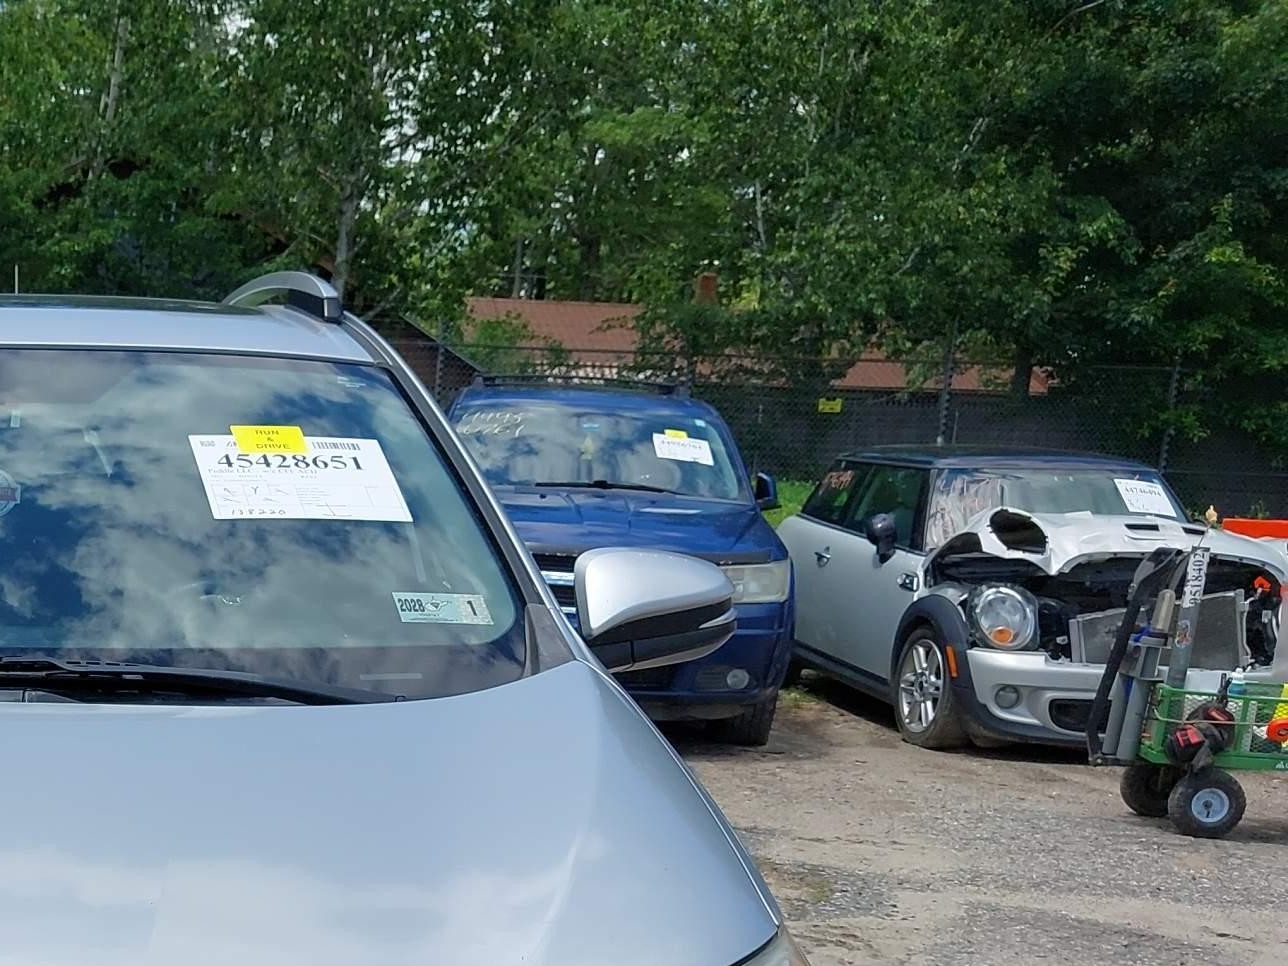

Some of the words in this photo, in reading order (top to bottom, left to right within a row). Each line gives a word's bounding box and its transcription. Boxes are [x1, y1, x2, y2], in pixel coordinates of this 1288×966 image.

[217, 453, 365, 470] 45428651
[398, 598, 425, 612] 2028
[466, 600, 478, 616] 1
